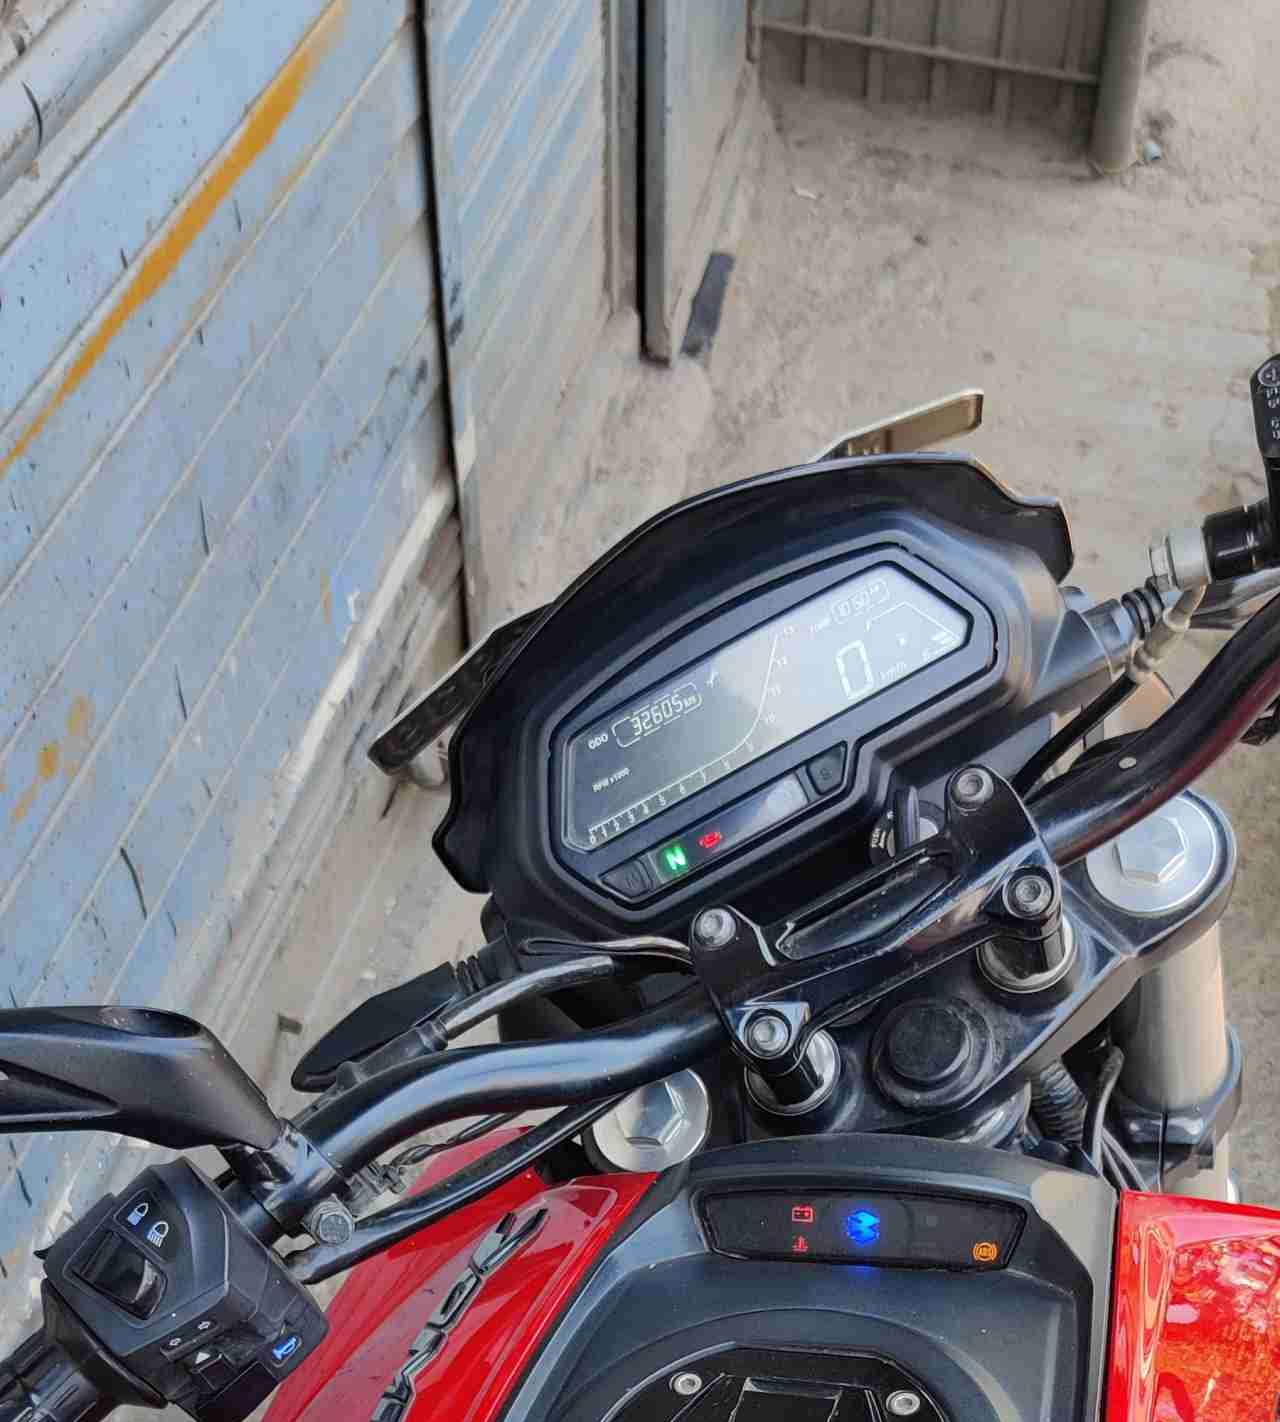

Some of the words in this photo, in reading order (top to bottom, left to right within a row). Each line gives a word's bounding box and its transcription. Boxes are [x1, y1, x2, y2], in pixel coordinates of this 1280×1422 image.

[588, 733, 609, 750] ODO
[631, 694, 684, 737] 32605
[666, 845, 688, 870] N
